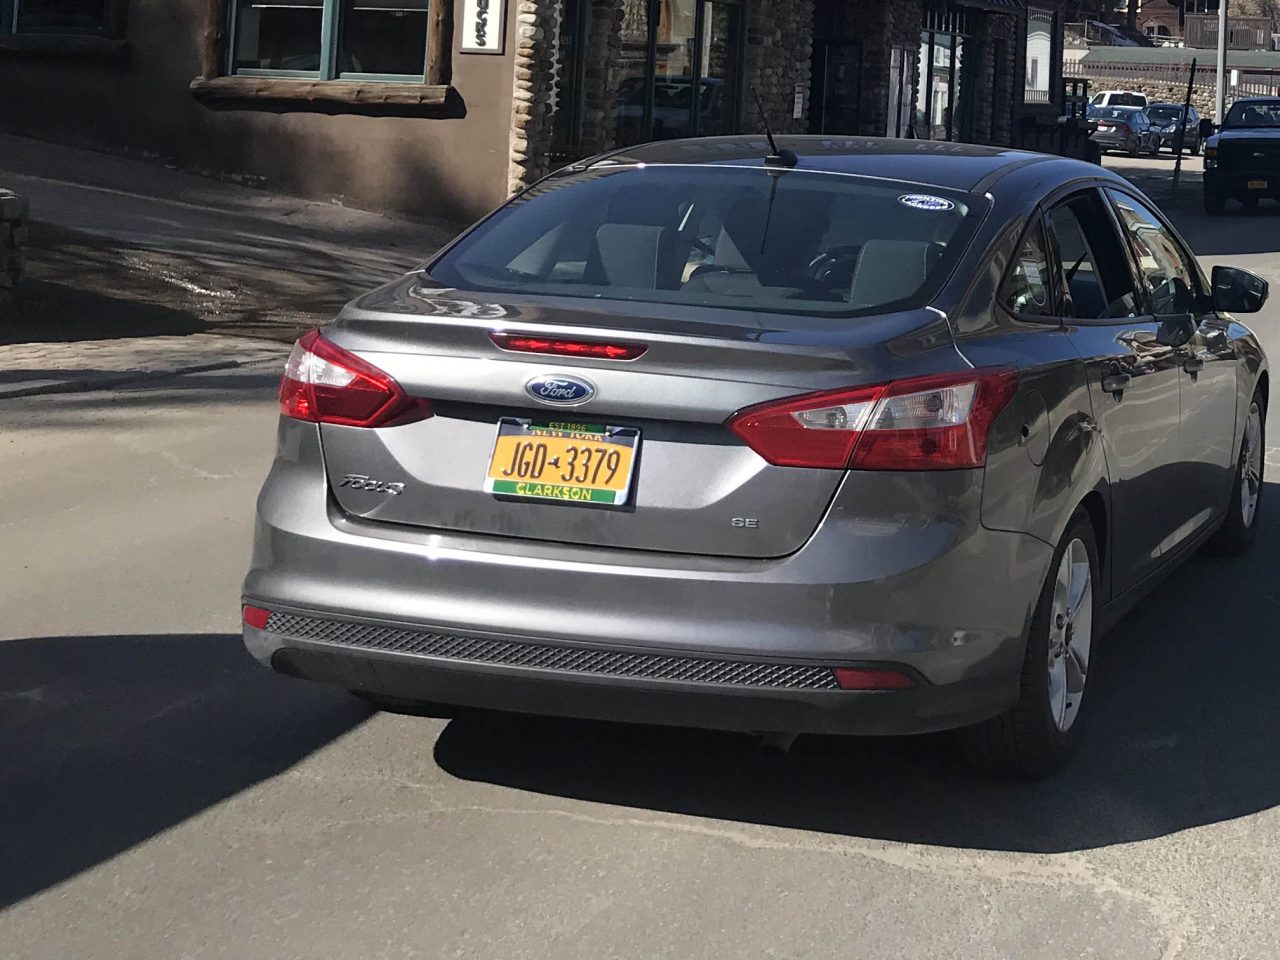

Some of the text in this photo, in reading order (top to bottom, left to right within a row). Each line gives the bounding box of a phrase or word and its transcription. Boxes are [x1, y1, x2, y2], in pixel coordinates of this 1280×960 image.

[540, 379, 576, 398] Ford
[516, 482, 592, 501] CLARKSON
[731, 517, 758, 528] SE
